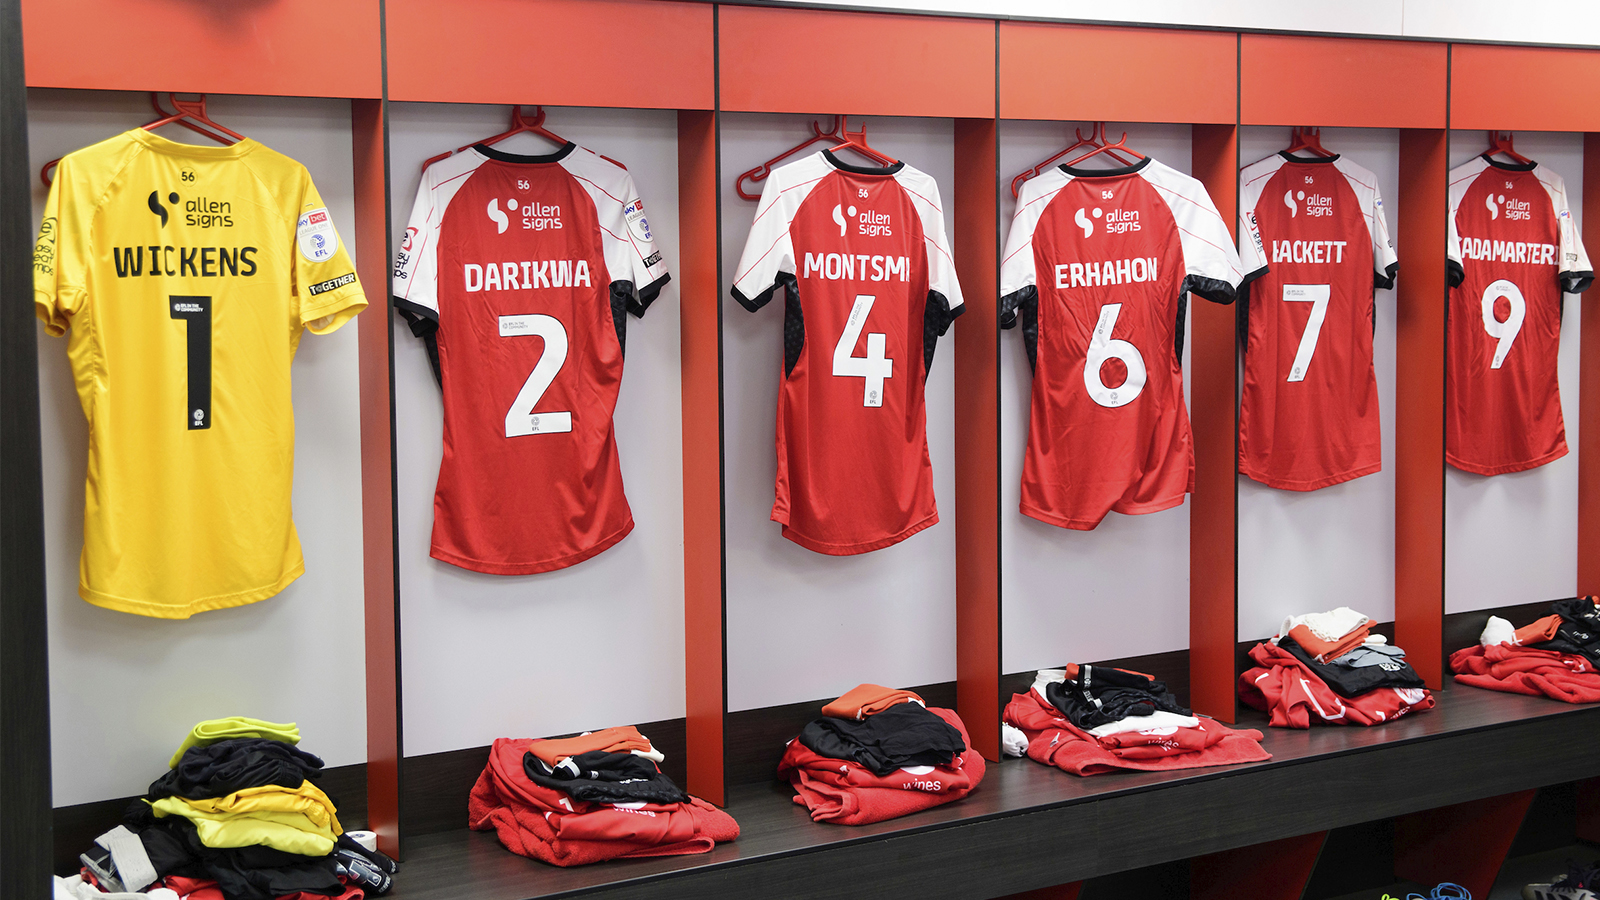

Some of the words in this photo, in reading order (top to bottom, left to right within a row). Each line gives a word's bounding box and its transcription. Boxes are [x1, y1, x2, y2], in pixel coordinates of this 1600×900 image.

[181, 172, 195, 181] 56
[1305, 176, 1313, 184] 56
[518, 180, 530, 190] 56
[858, 189, 868, 198] 56
[1102, 190, 1113, 199] 56
[1307, 194, 1332, 206] allen
[186, 197, 231, 213] allen
[522, 202, 560, 216] allen
[625, 206, 635, 215] sky
[1506, 199, 1530, 210] allen
[859, 210, 890, 225] allen
[1106, 209, 1139, 222] allen
[1307, 206, 1333, 217] signs
[1506, 211, 1530, 220] signs
[186, 214, 233, 228] signs
[298, 219, 308, 227] sky
[309, 212, 327, 224] bet
[522, 218, 563, 231] signs
[299, 226, 317, 235] LEAGUE
[859, 224, 892, 237] signs
[1106, 221, 1141, 234] signs
[315, 249, 328, 257] EFL
[1458, 236, 1559, 265] ADAMARTERI
[114, 246, 258, 278] WICKENS
[803, 252, 910, 282] MONTSM
[464, 260, 591, 292] DARIKWA
[1055, 257, 1157, 289] ERHAHON
[1481, 279, 1526, 369] 9
[1283, 284, 1330, 382] 7
[832, 294, 893, 408] 4
[1084, 303, 1148, 408] 6
[169, 295, 212, 430] 1
[499, 314, 572, 438] 2
